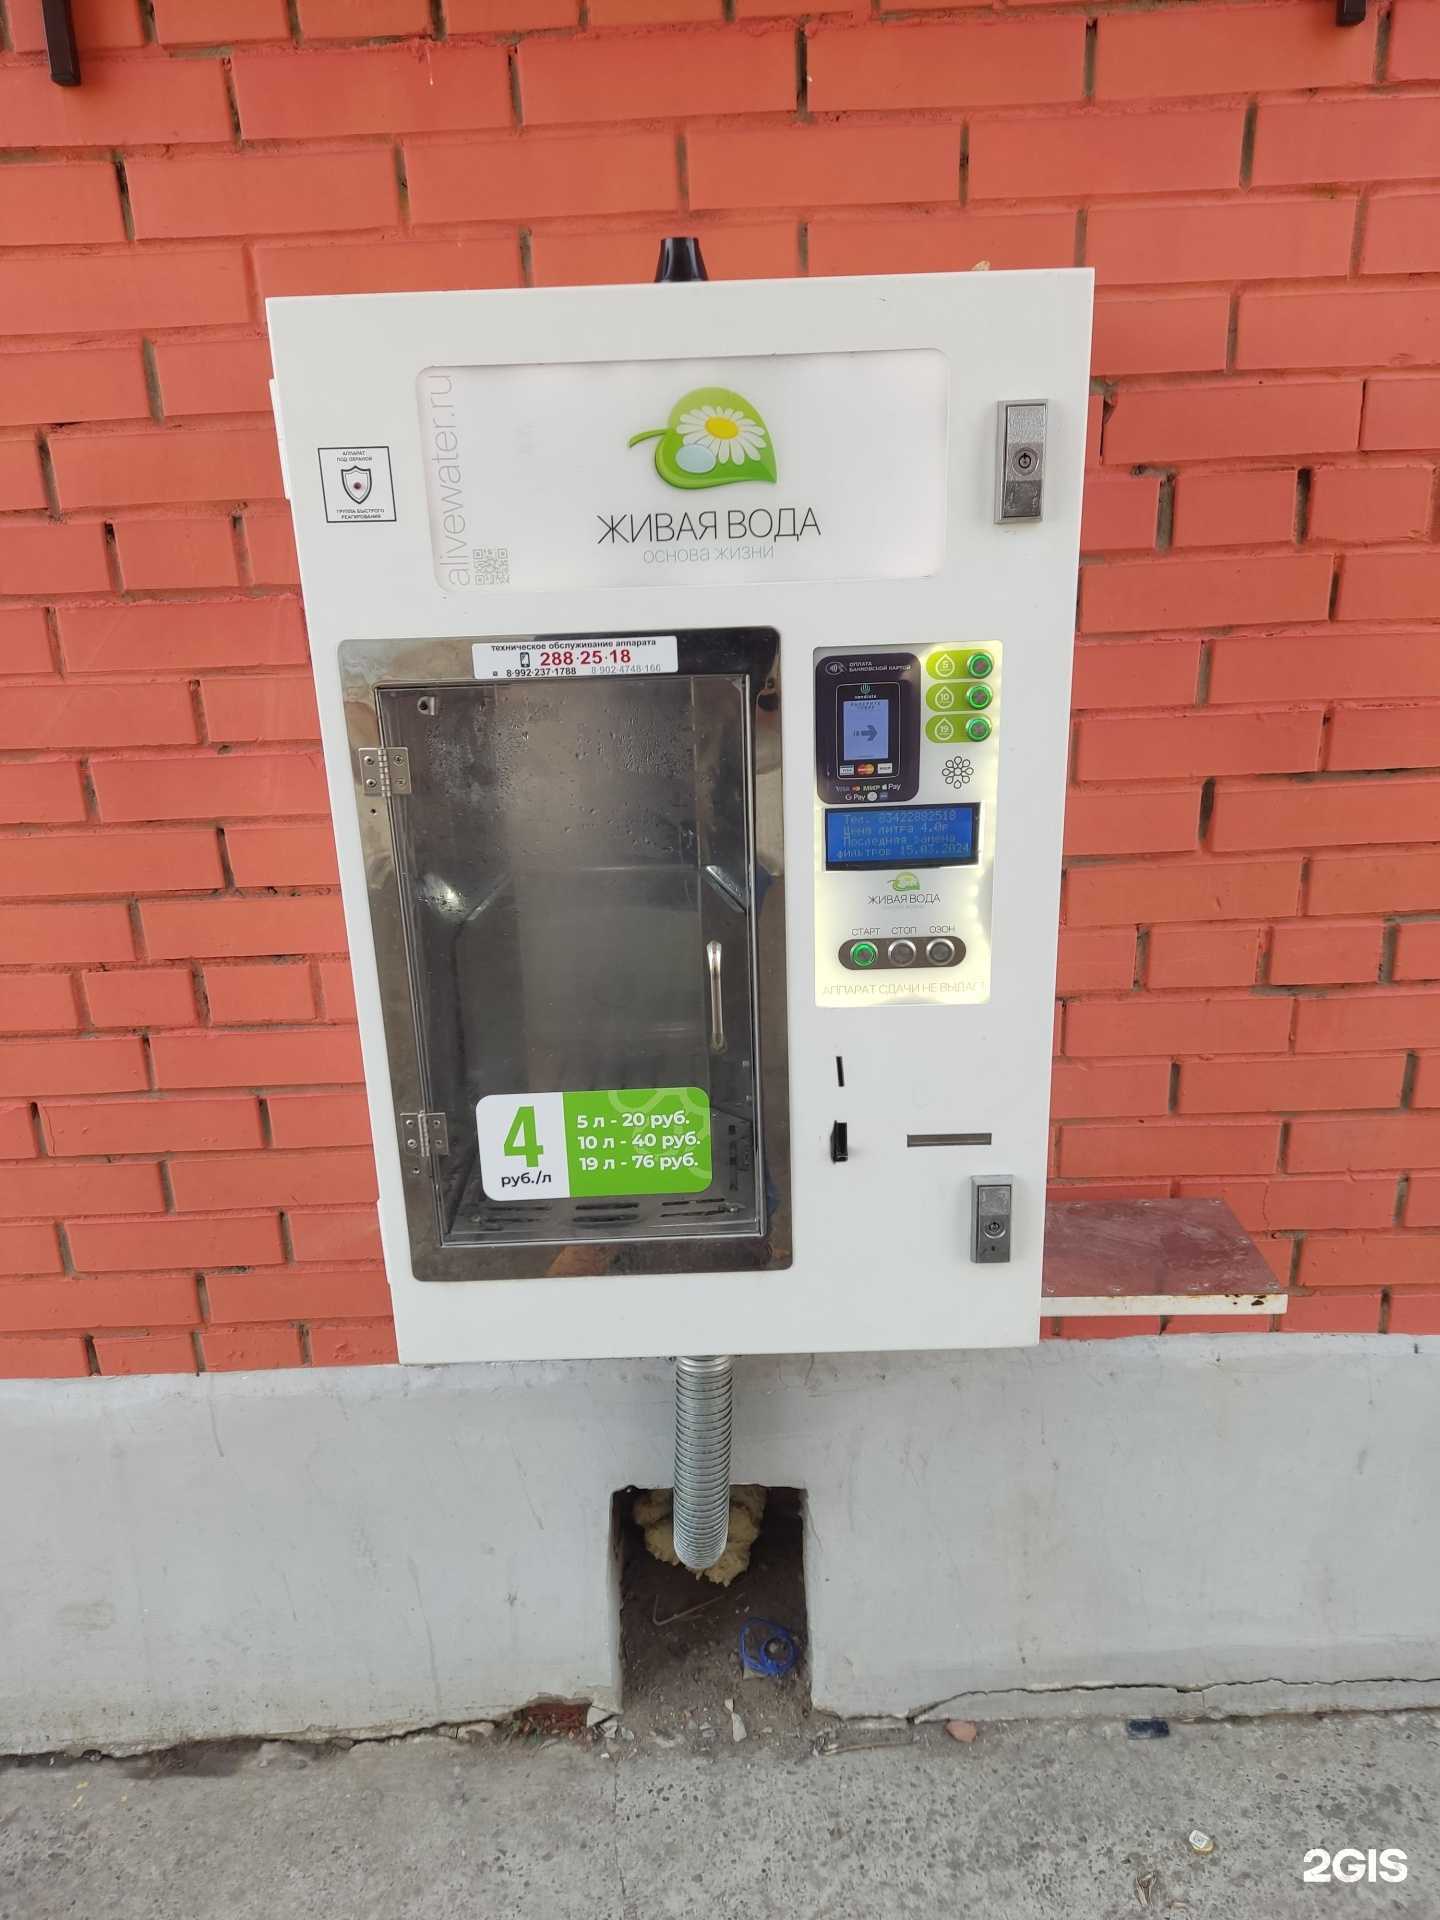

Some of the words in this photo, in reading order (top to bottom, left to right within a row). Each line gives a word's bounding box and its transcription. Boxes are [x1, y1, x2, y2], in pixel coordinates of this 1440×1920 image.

[430, 375, 470, 587] alivewater.ru
[596, 511, 718, 544] ЖИВАЯ
[727, 507, 822, 543] ВОДА
[491, 643, 547, 652] техническое
[548, 640, 614, 652] обслуживание
[615, 639, 657, 649] аппарата
[941, 693, 950, 701] 10
[888, 783, 902, 791] Pay
[853, 793, 866, 801] Pay
[867, 894, 908, 905] ЖИВАЯ
[909, 893, 941, 904] ВОДА
[851, 928, 881, 936] СТАРТ
[891, 926, 917, 935] СТОП
[929, 924, 956, 934] ОЗОН
[823, 984, 877, 995] АППАРАТ
[878, 983, 920, 995] СДАЧИ
[922, 983, 937, 993] НЕ
[577, 1115, 588, 1129] 5
[592, 1117, 605, 1129] л
[622, 1113, 645, 1127] 20
[650, 1110, 690, 1129] руб.
[503, 1105, 545, 1168] 4
[578, 1136, 597, 1150] 10
[602, 1137, 615, 1149] л
[631, 1134, 656, 1147] 40
[662, 1131, 701, 1149] руб.
[579, 1157, 598, 1171] 19
[602, 1159, 615, 1170] л
[631, 1155, 654, 1169] 76
[660, 1153, 699, 1171] руб.
[501, 1171, 552, 1188] руб./л
